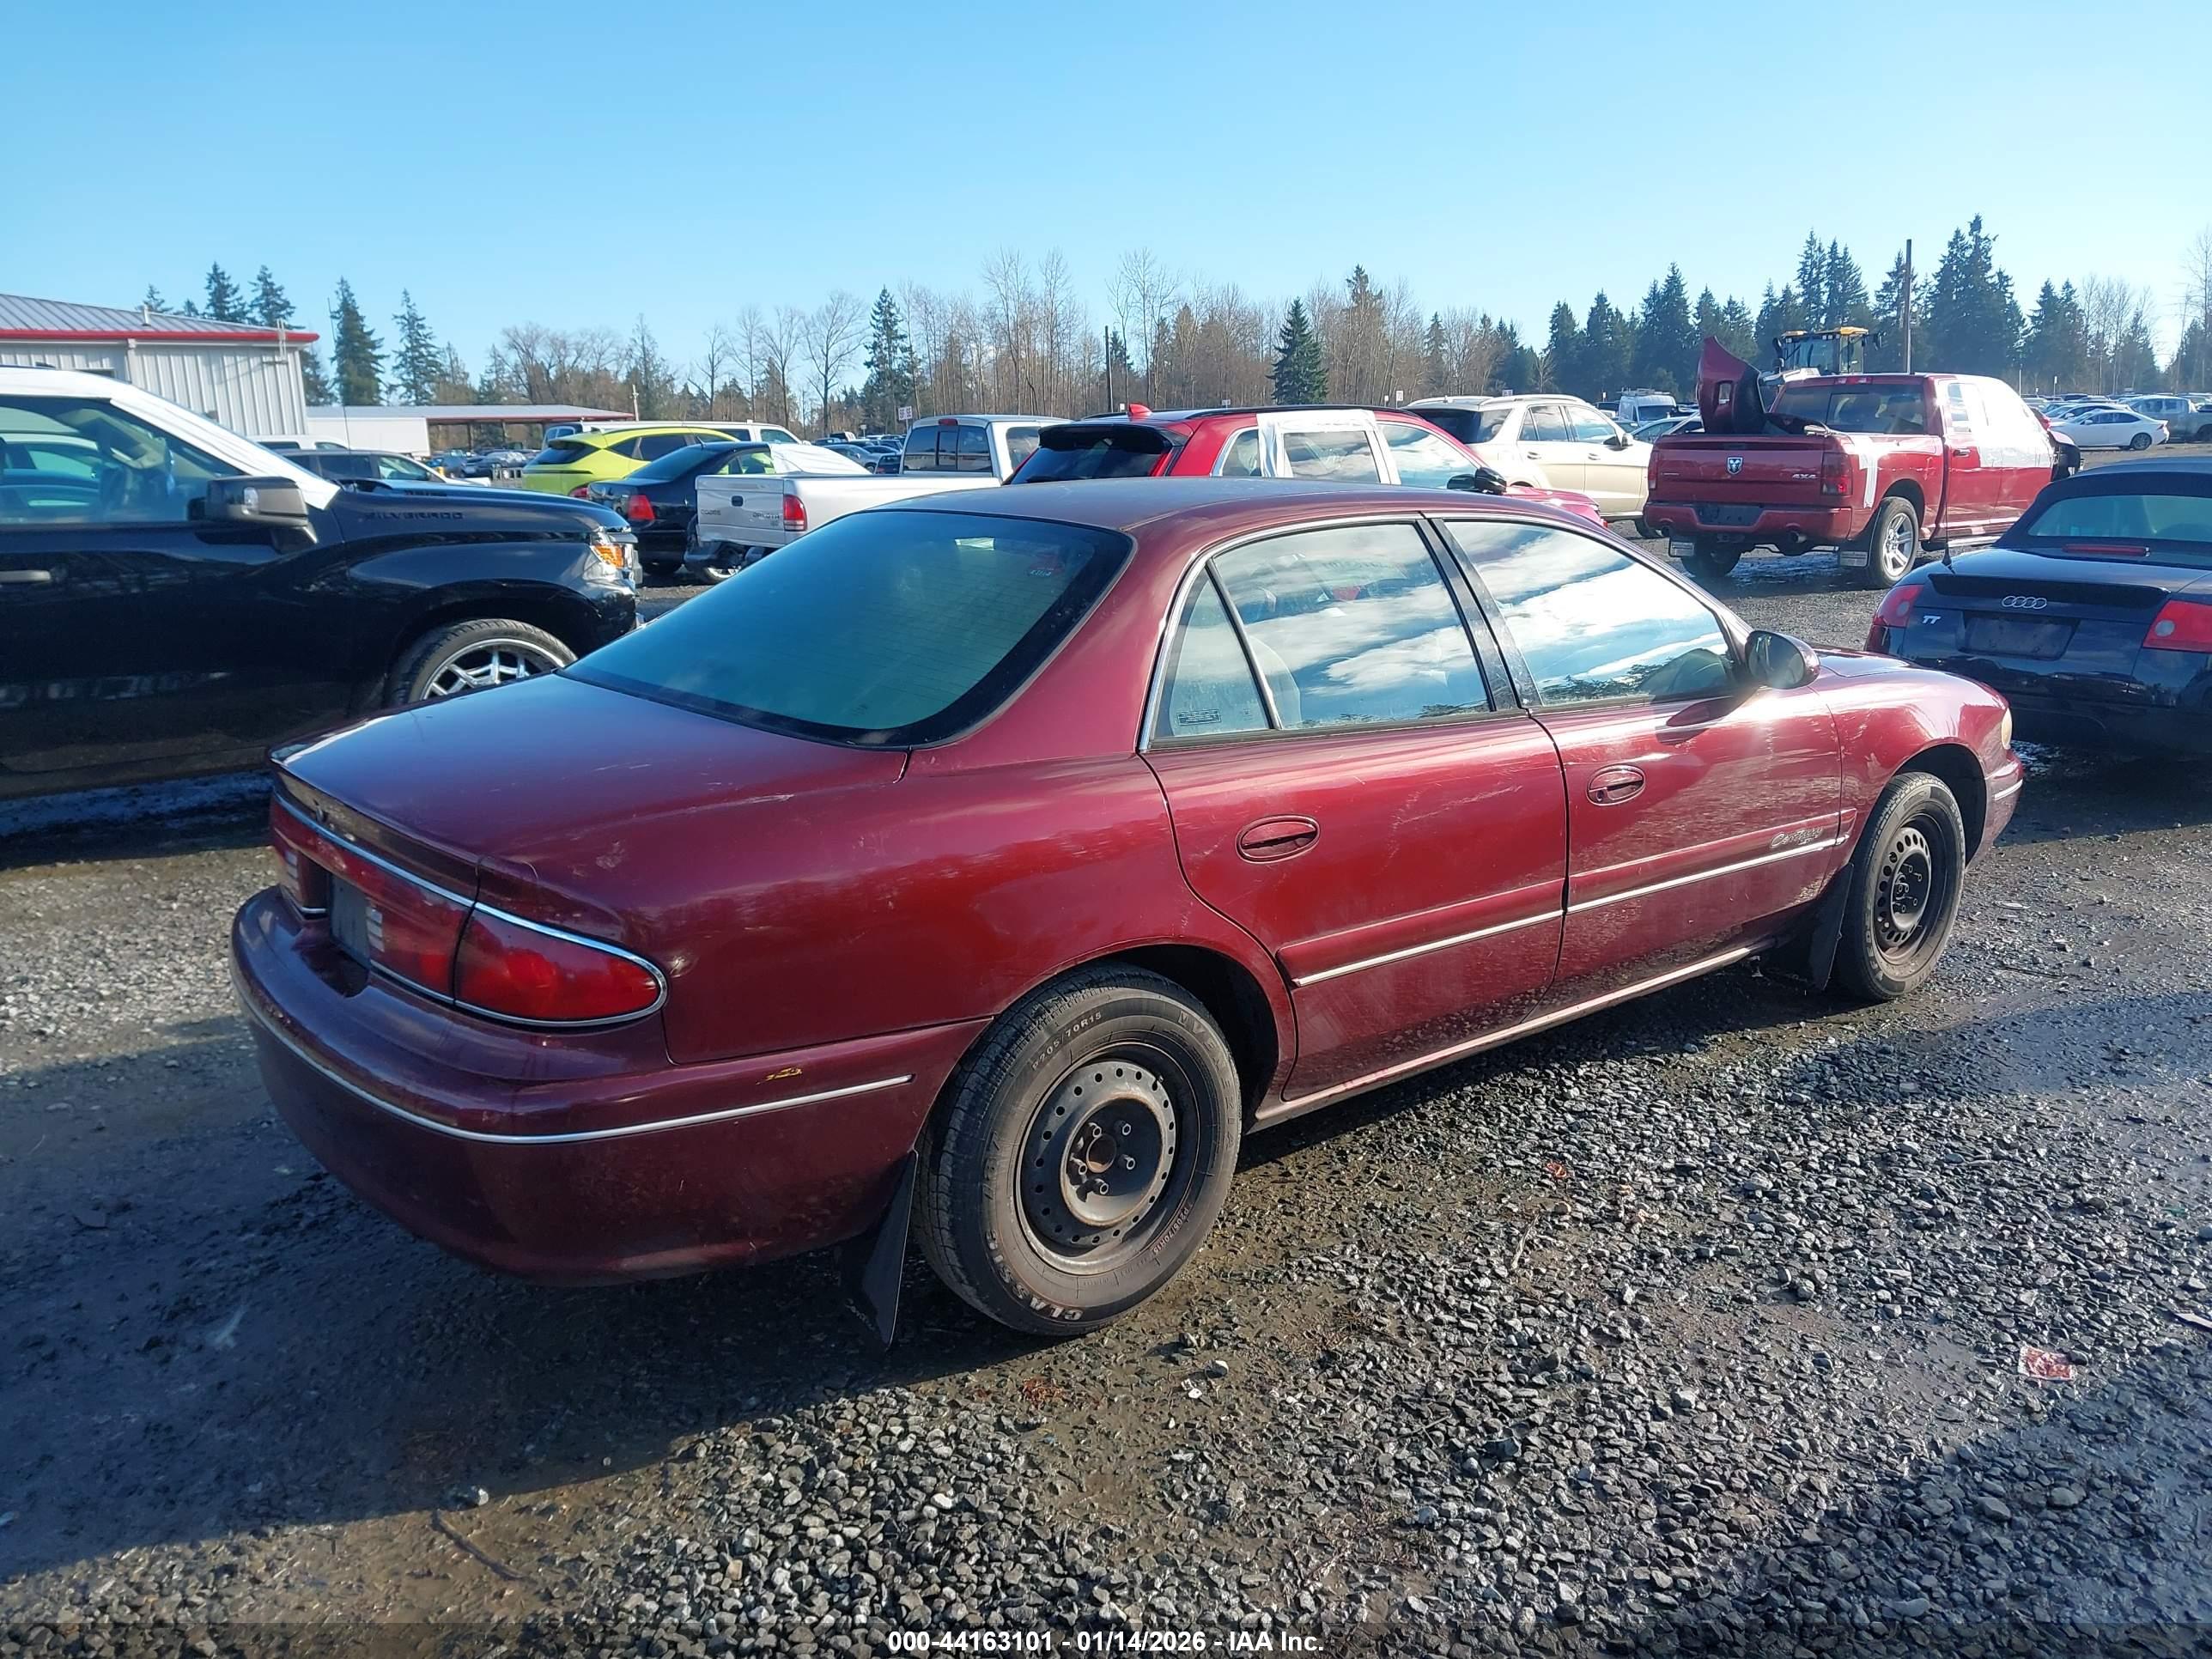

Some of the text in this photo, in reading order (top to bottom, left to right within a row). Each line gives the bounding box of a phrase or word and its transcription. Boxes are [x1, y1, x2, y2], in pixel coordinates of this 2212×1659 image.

[1922, 615, 1942, 624] TT
[1032, 1012, 1102, 1071] P205/70R15
[985, 1228, 1084, 1321] CLASSIC
